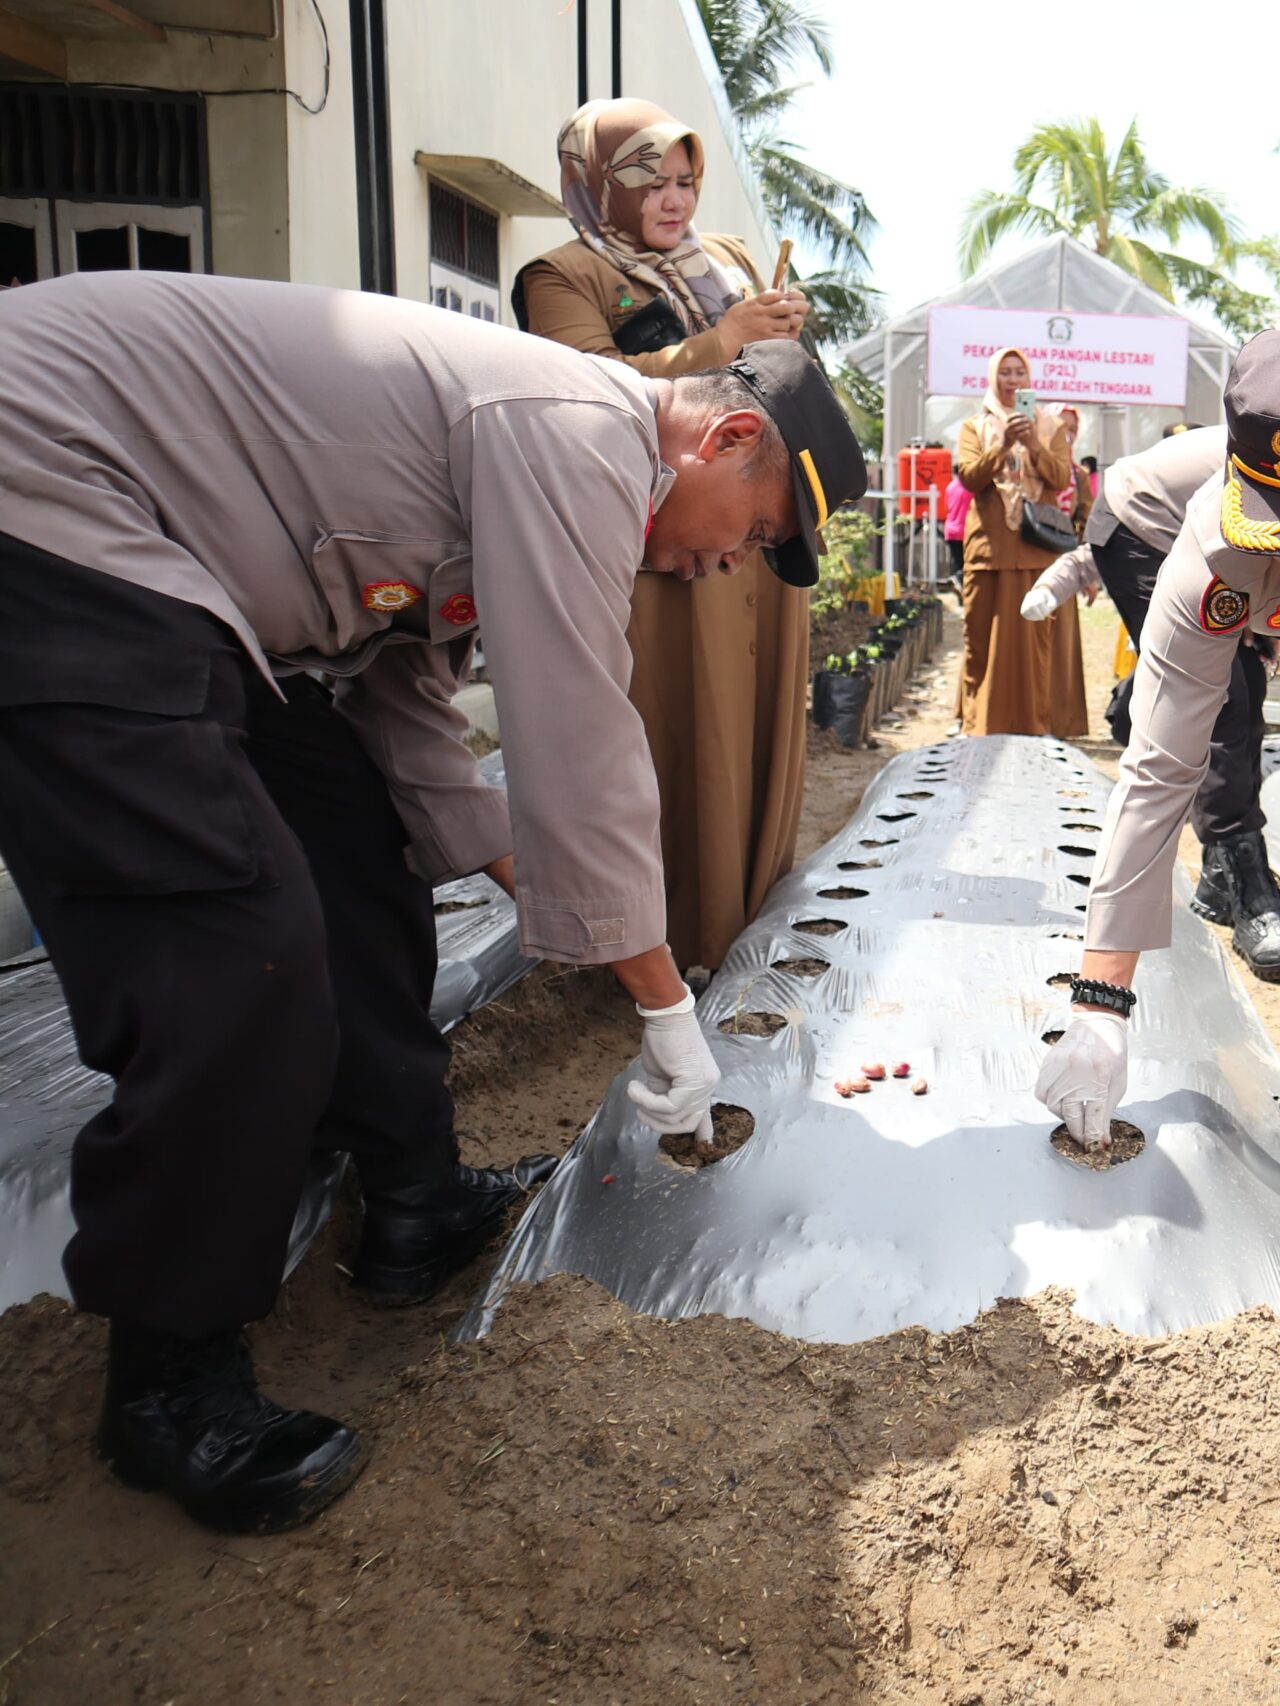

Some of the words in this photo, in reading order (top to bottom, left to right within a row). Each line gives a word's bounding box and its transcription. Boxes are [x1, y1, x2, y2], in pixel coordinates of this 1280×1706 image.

[1051, 348, 1100, 362] PANGAN
[1104, 352, 1154, 365] LESTARI
[1043, 363, 1077, 378] (P2L)
[962, 376, 977, 389] PC
[1062, 380, 1090, 392] ACEH
[1094, 382, 1152, 395] TENGGARA
